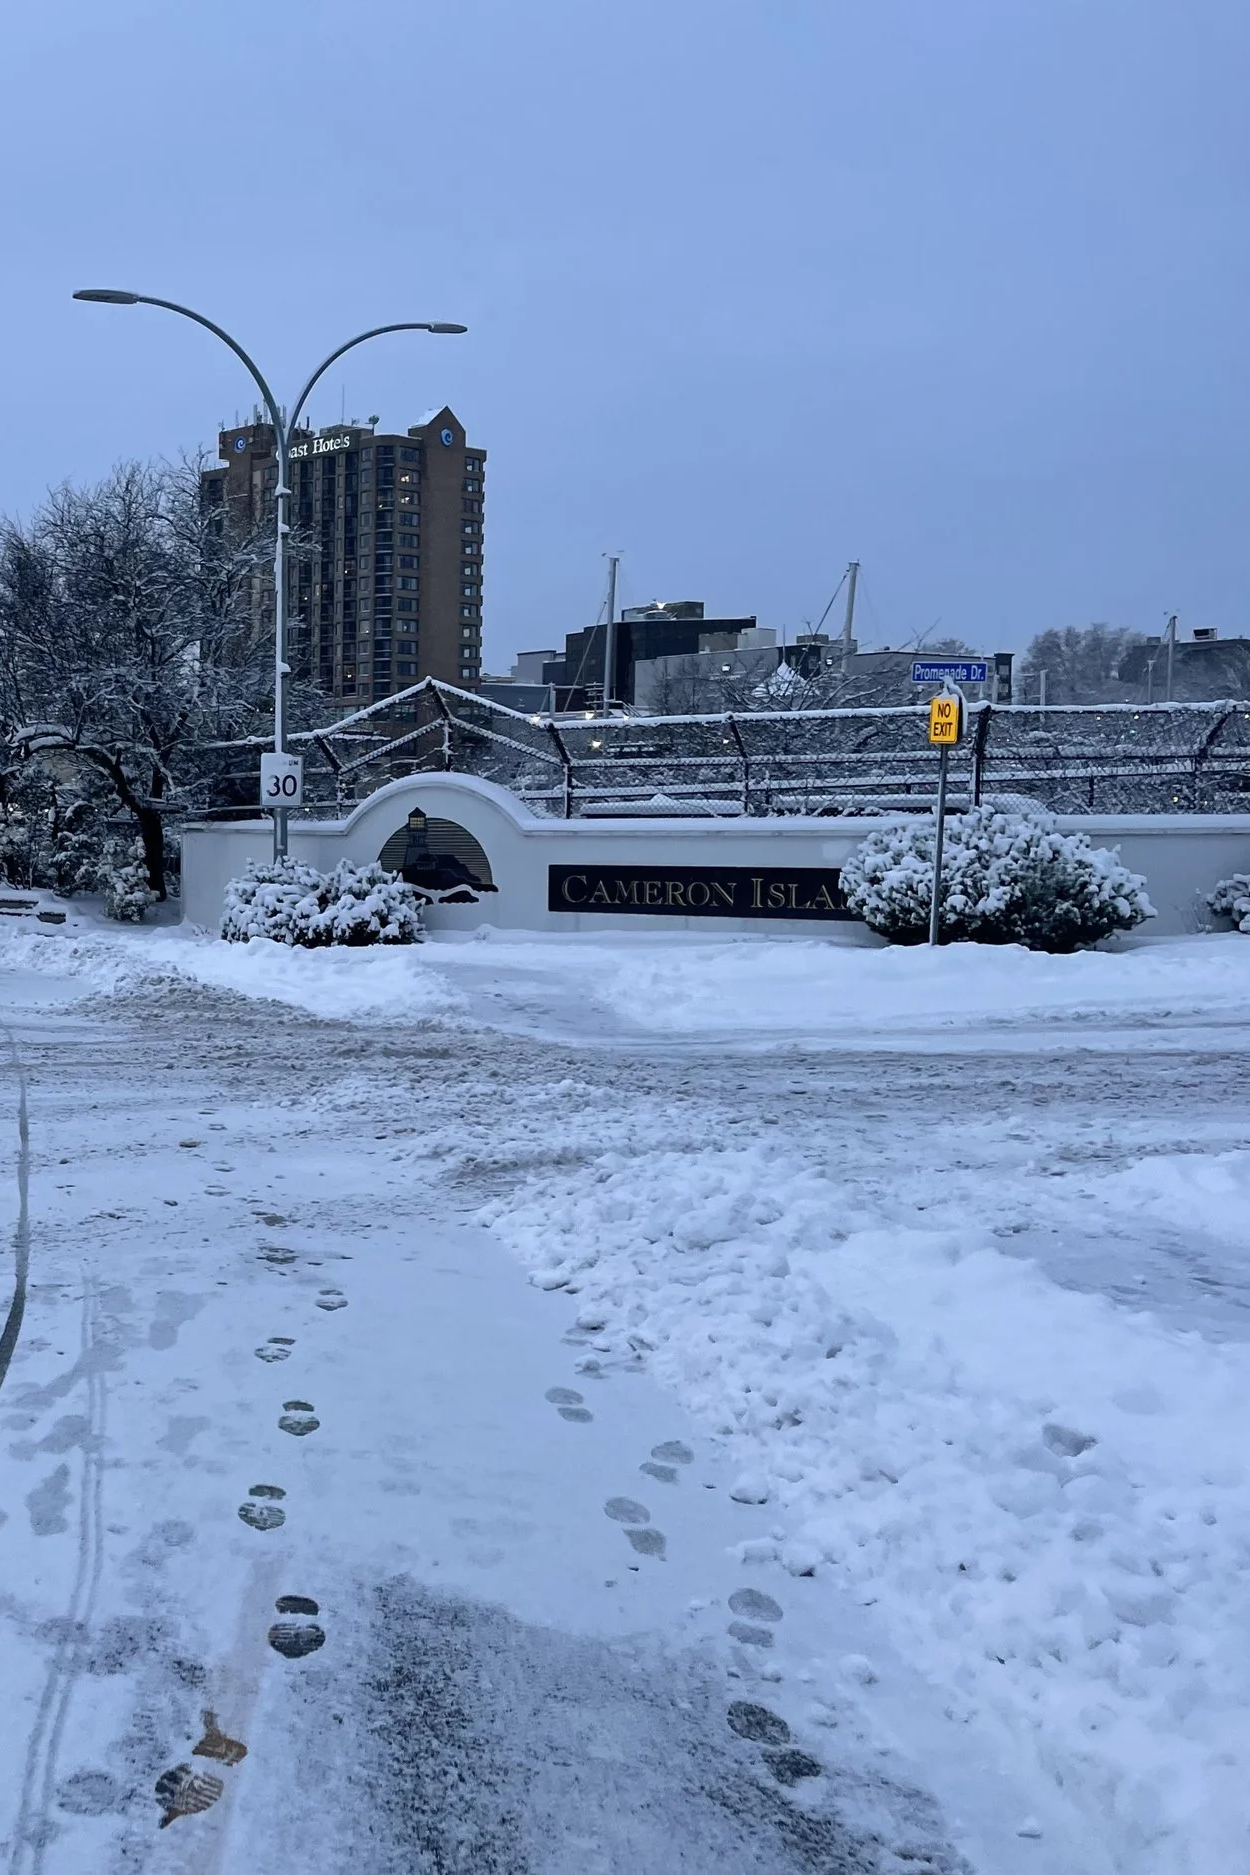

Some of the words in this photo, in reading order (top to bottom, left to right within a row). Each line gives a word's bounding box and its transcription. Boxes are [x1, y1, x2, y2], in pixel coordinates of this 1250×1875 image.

[276, 443, 308, 460] ast
[312, 434, 350, 454] Hotels
[914, 664, 967, 680] Promenade
[970, 665, 984, 680] Dr.
[938, 703, 951, 718] NO
[933, 722, 953, 737] EXIT
[266, 774, 297, 797] 30
[562, 875, 737, 906] CAMERON
